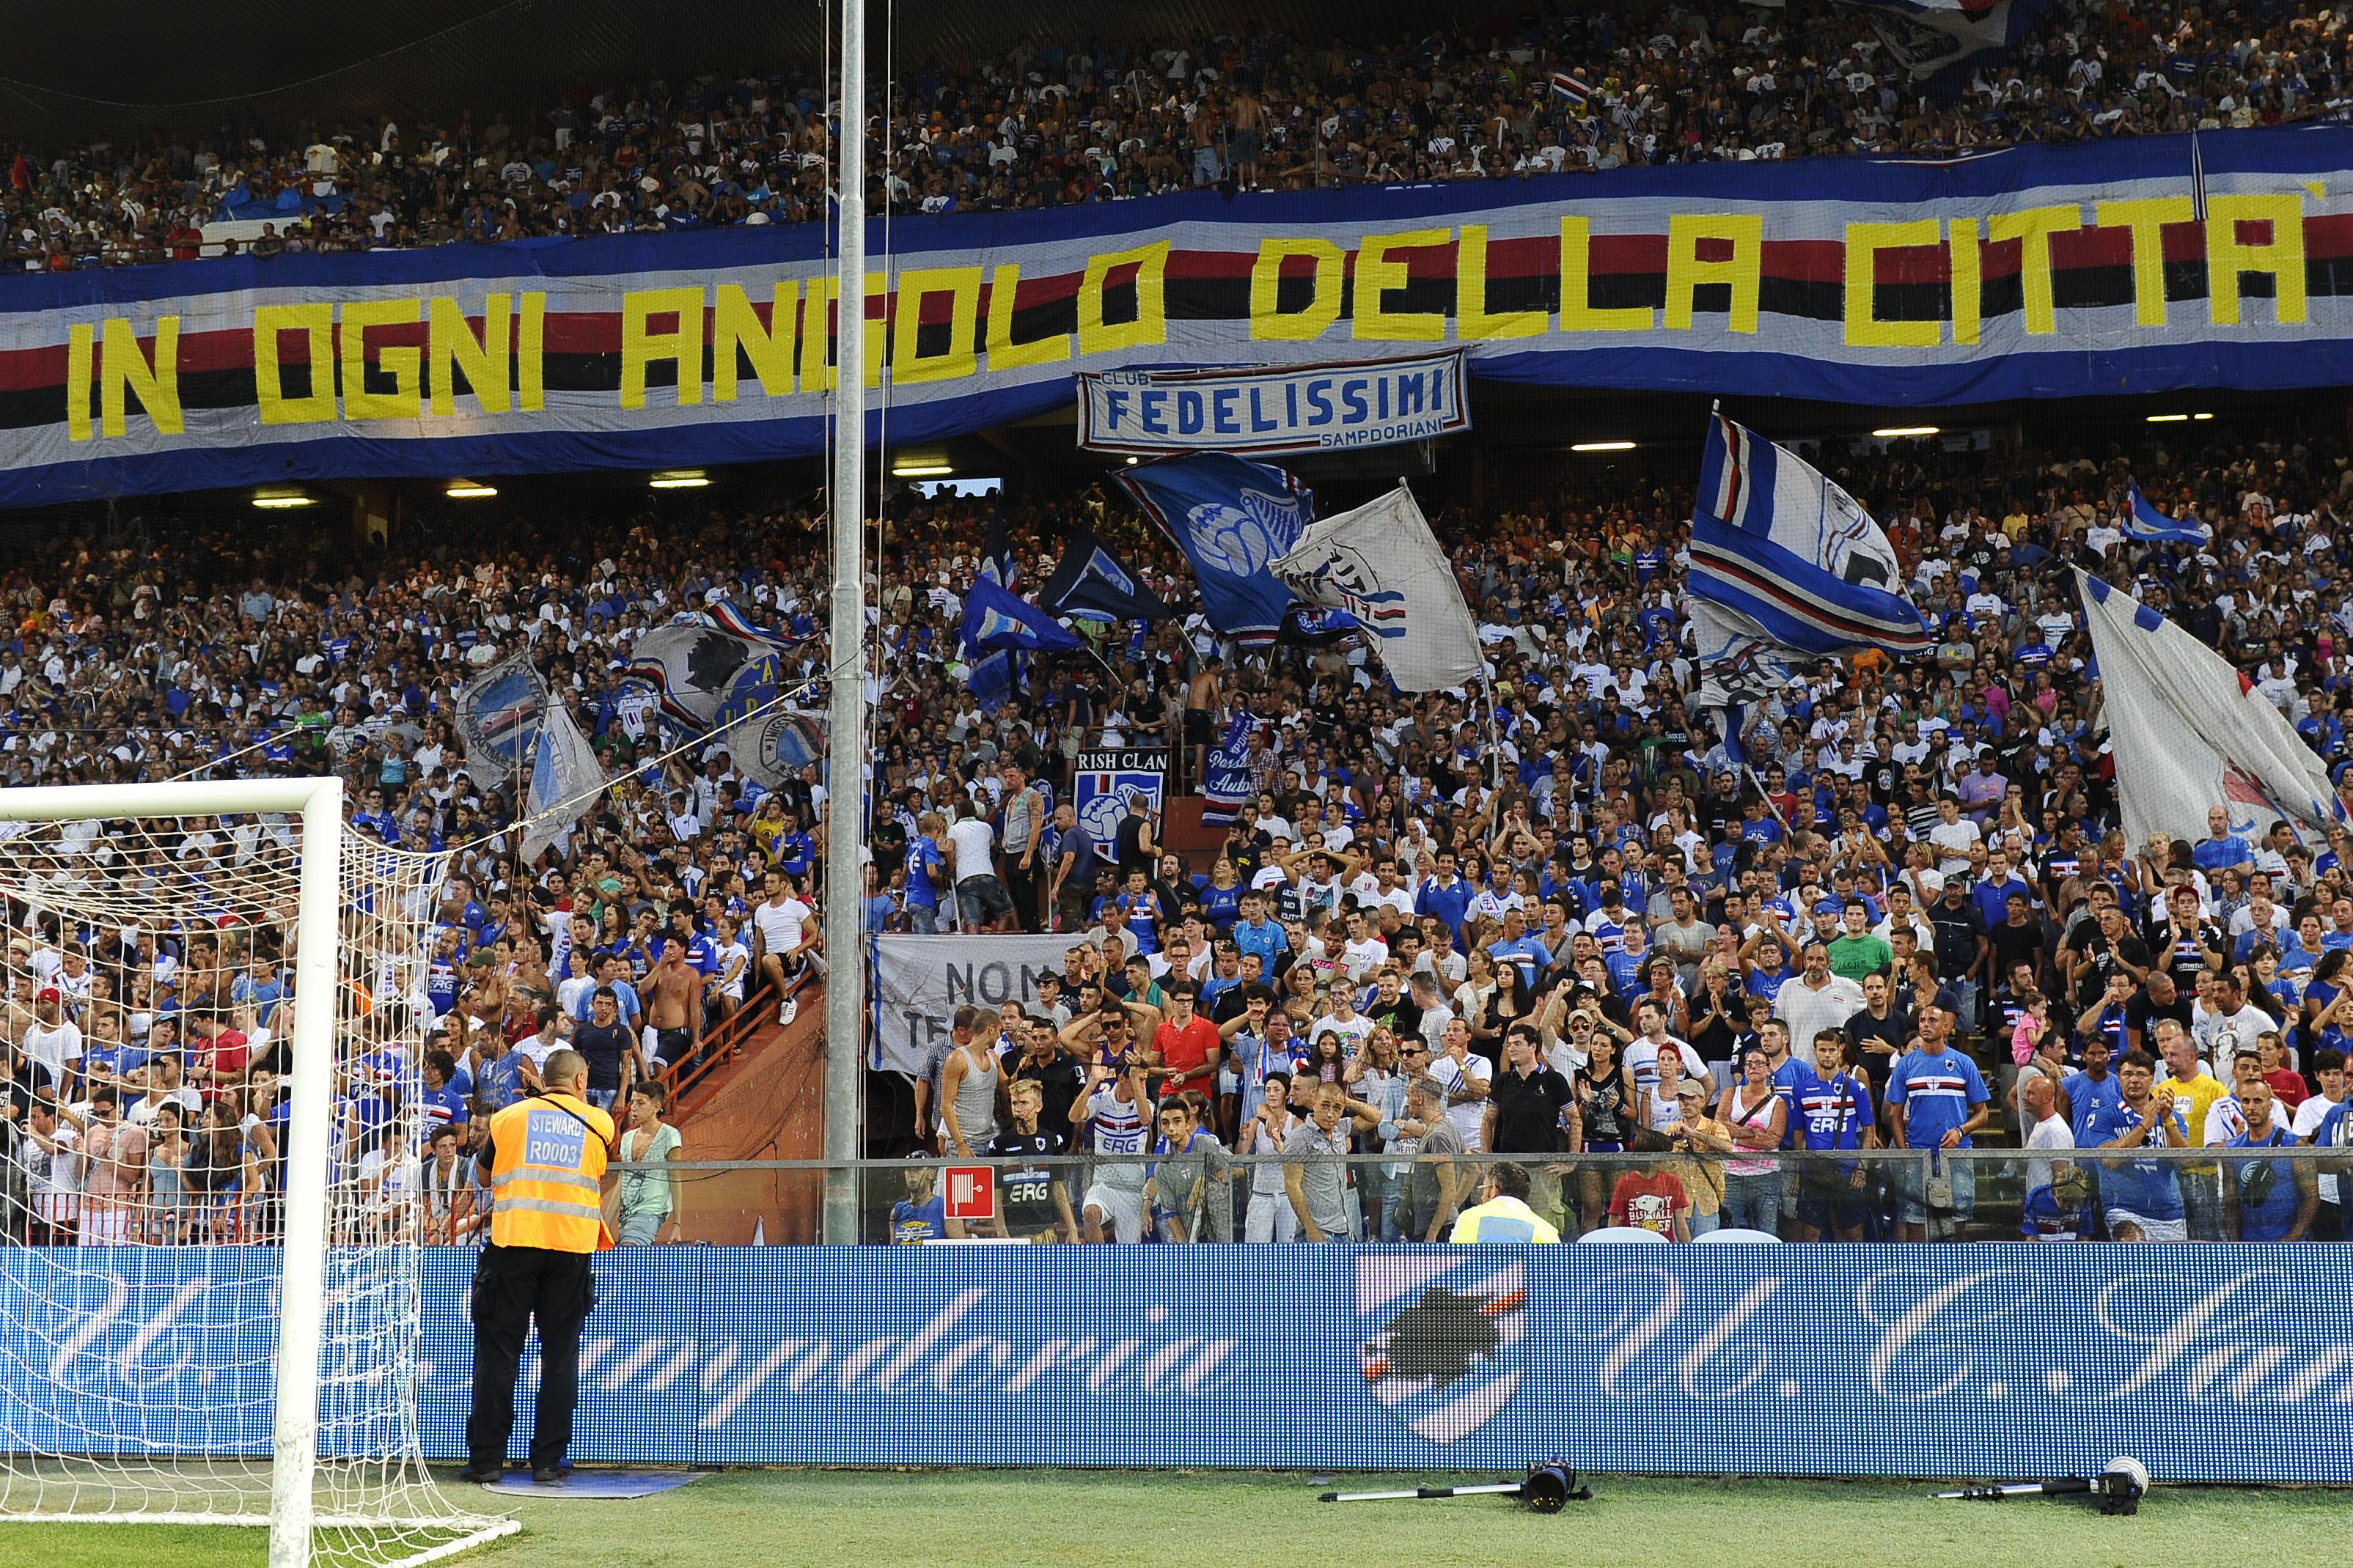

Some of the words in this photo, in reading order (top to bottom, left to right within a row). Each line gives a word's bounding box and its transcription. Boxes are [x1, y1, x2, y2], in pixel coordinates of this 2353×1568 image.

[67, 315, 184, 441] IN
[254, 291, 546, 425] OGNI
[620, 238, 1171, 410] ANGOLO
[1249, 214, 1762, 341] DELLA
[1101, 372, 1150, 386] CLUB
[1106, 369, 1444, 435] FEDELISSIMI
[1321, 418, 1444, 448] SAMPDORIANI
[1073, 753, 1116, 770] RISH
[1122, 752, 1168, 770] CLAN
[429, 979, 455, 990] ERG
[532, 1113, 582, 1138] STEWARD
[1810, 1117, 1848, 1133] ERG
[529, 1140, 578, 1164] R0003
[1102, 1138, 1138, 1154] ERG
[1010, 1182, 1048, 1202] ERG
